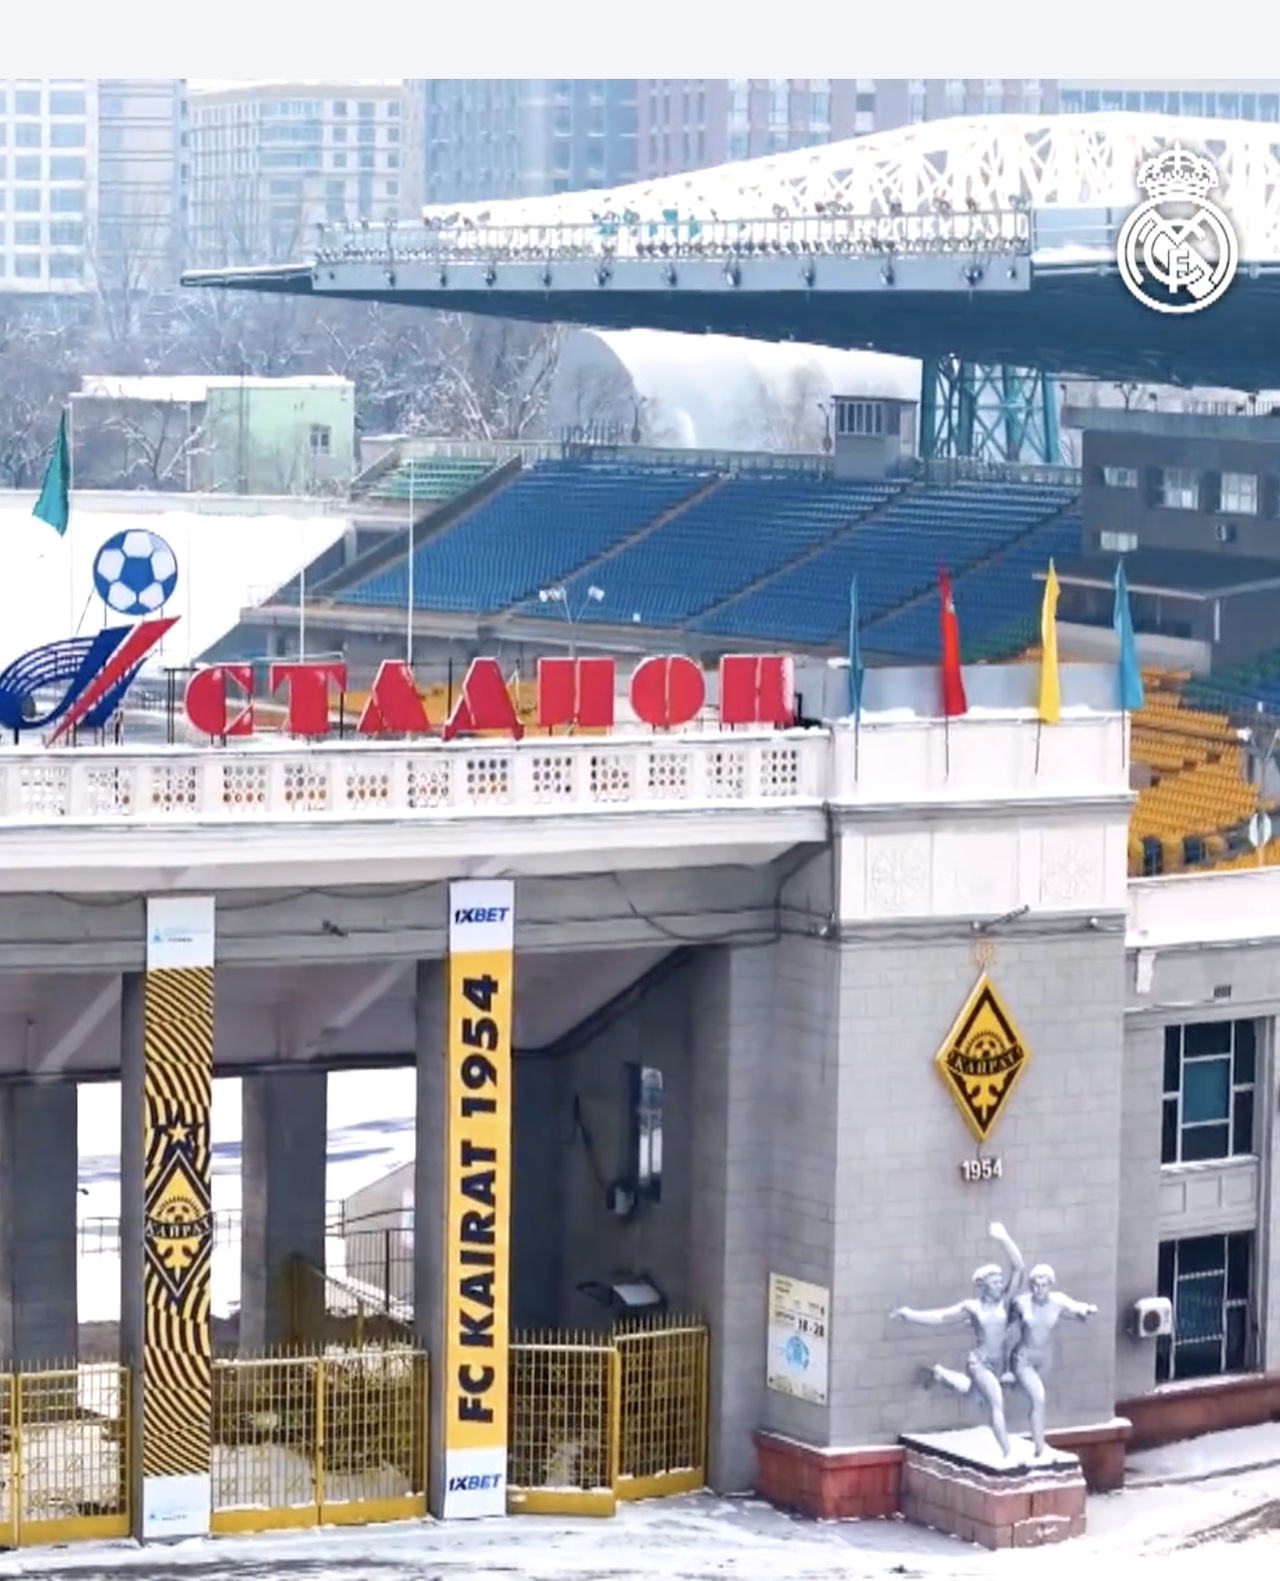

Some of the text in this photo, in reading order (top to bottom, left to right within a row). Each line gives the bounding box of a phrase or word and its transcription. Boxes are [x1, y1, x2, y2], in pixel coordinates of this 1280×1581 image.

[183, 656, 796, 741] СТАДИОН
[454, 907, 510, 924] 1XBET
[962, 1158, 1003, 1180] 1954
[458, 974, 499, 1424] FC KAIRAT 1954
[449, 1473, 503, 1491] 1XBET
